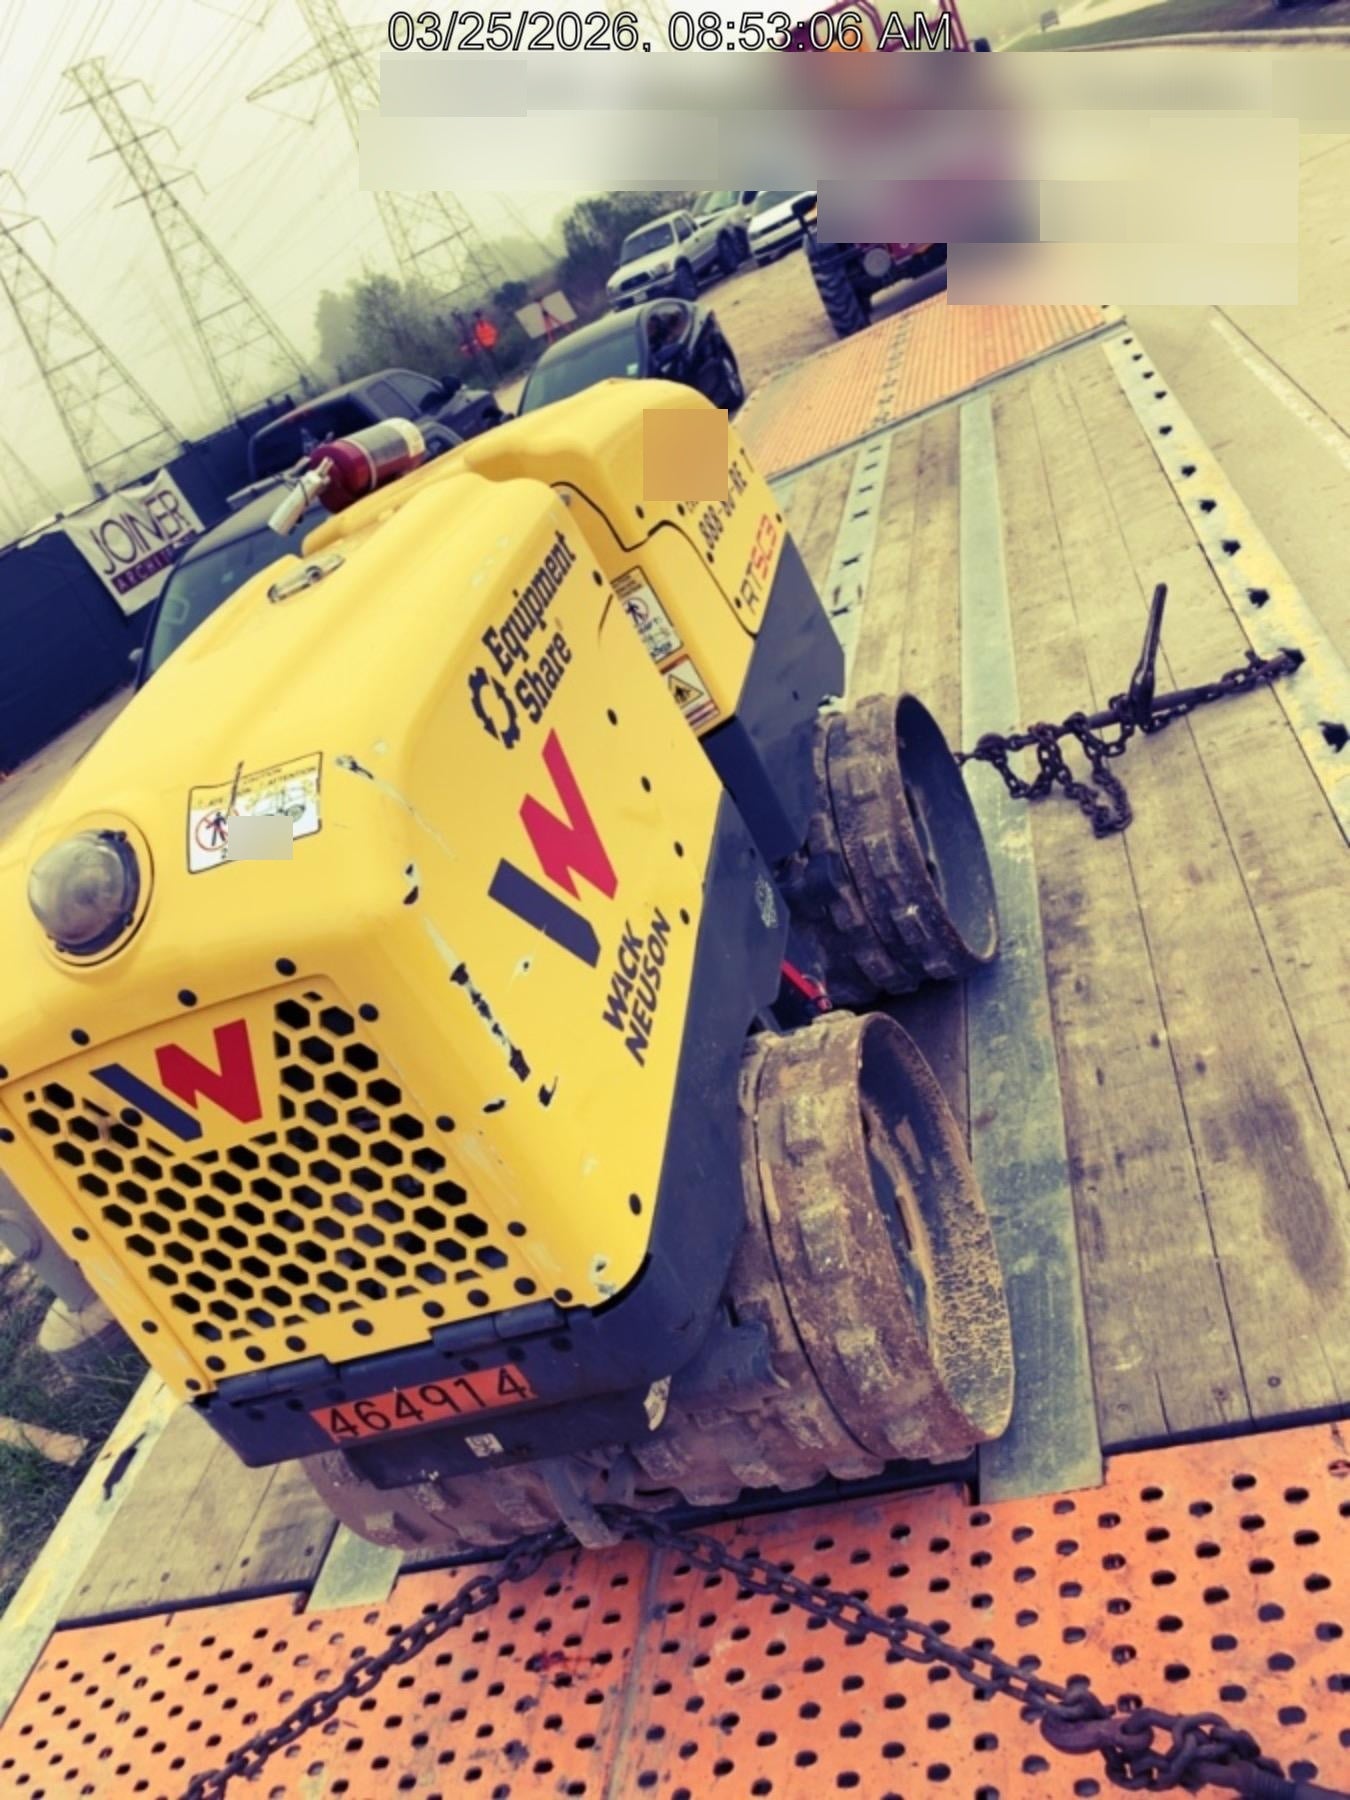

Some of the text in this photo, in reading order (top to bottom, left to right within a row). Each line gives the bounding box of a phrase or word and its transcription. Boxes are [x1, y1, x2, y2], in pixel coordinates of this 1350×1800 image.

[89, 489, 192, 575] JOINER
[481, 530, 576, 677] Equipment
[514, 632, 573, 724] Share
[602, 918, 644, 1032] WACK
[625, 906, 671, 1068] NEUSON
[330, 1367, 528, 1438] 464914
